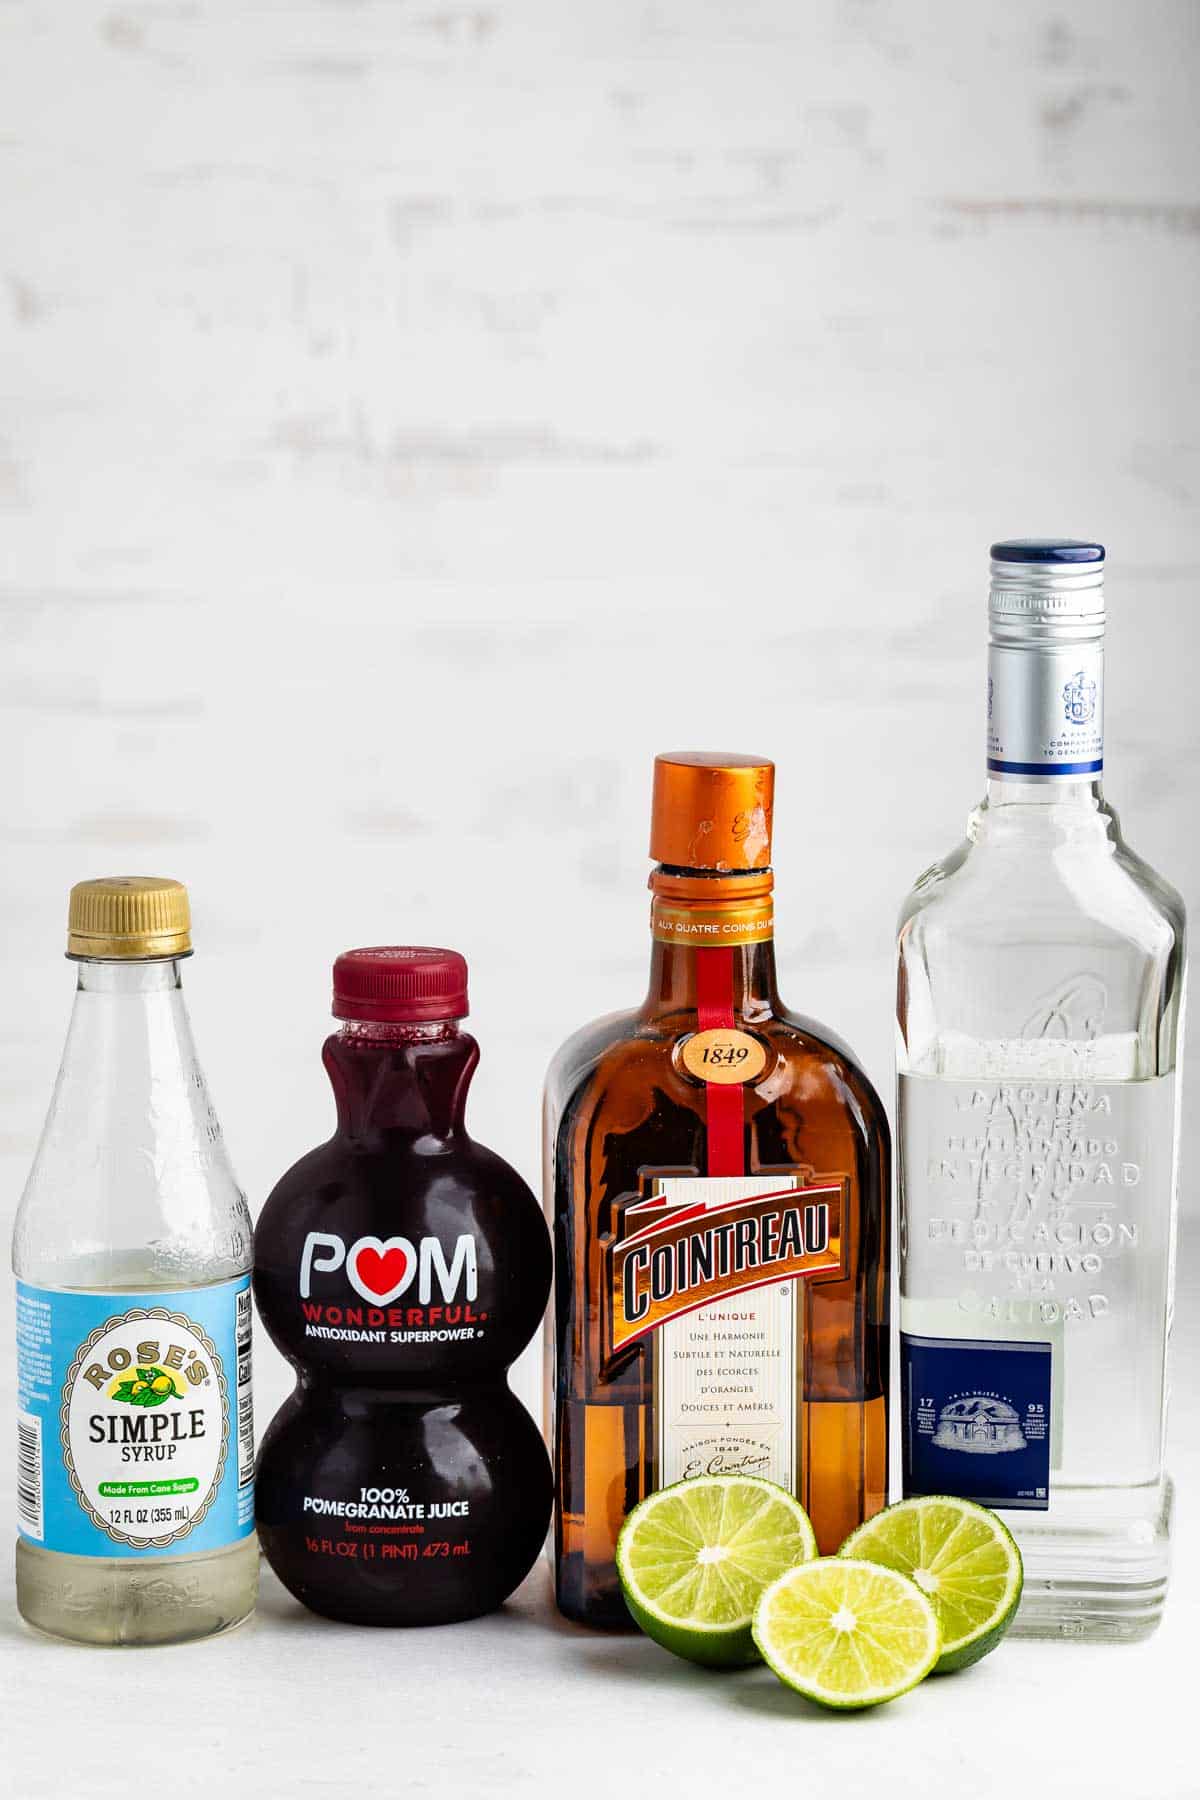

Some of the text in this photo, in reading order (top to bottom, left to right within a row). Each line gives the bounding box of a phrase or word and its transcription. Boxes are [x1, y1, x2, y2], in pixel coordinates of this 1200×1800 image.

[658, 920, 673, 931] AUX
[675, 923, 720, 934] QUATRE
[722, 923, 755, 934] COINS
[756, 921, 768, 931] DU
[702, 1048, 749, 1065] 1849
[300, 1232, 478, 1306] POM
[622, 1203, 830, 1323] COINTREAU
[698, 1312, 757, 1321] L'UNIQUE
[305, 1324, 475, 1343] ANTIOXIDANT SUPERPOWER
[83, 1341, 209, 1391] ROSE'S
[920, 1398, 934, 1408] 17
[1027, 1404, 1044, 1413] 95
[89, 1409, 206, 1443] SIMPLE
[121, 1444, 177, 1462] SYRUP
[682, 1439, 717, 1453] MAISON
[103, 1482, 196, 1495] Made From Cane Sugar
[360, 1488, 410, 1504] 100%
[110, 1505, 190, 1523] 12 FL OZ (355 mL)
[303, 1497, 470, 1519] POMEGRANATE JUICE
[345, 1520, 425, 1534] from concentrate
[305, 1536, 320, 1551] 16
[363, 1543, 376, 1560] (1
[381, 1544, 419, 1561] PINT)
[423, 1541, 450, 1557] 473
[453, 1539, 472, 1555] mL
